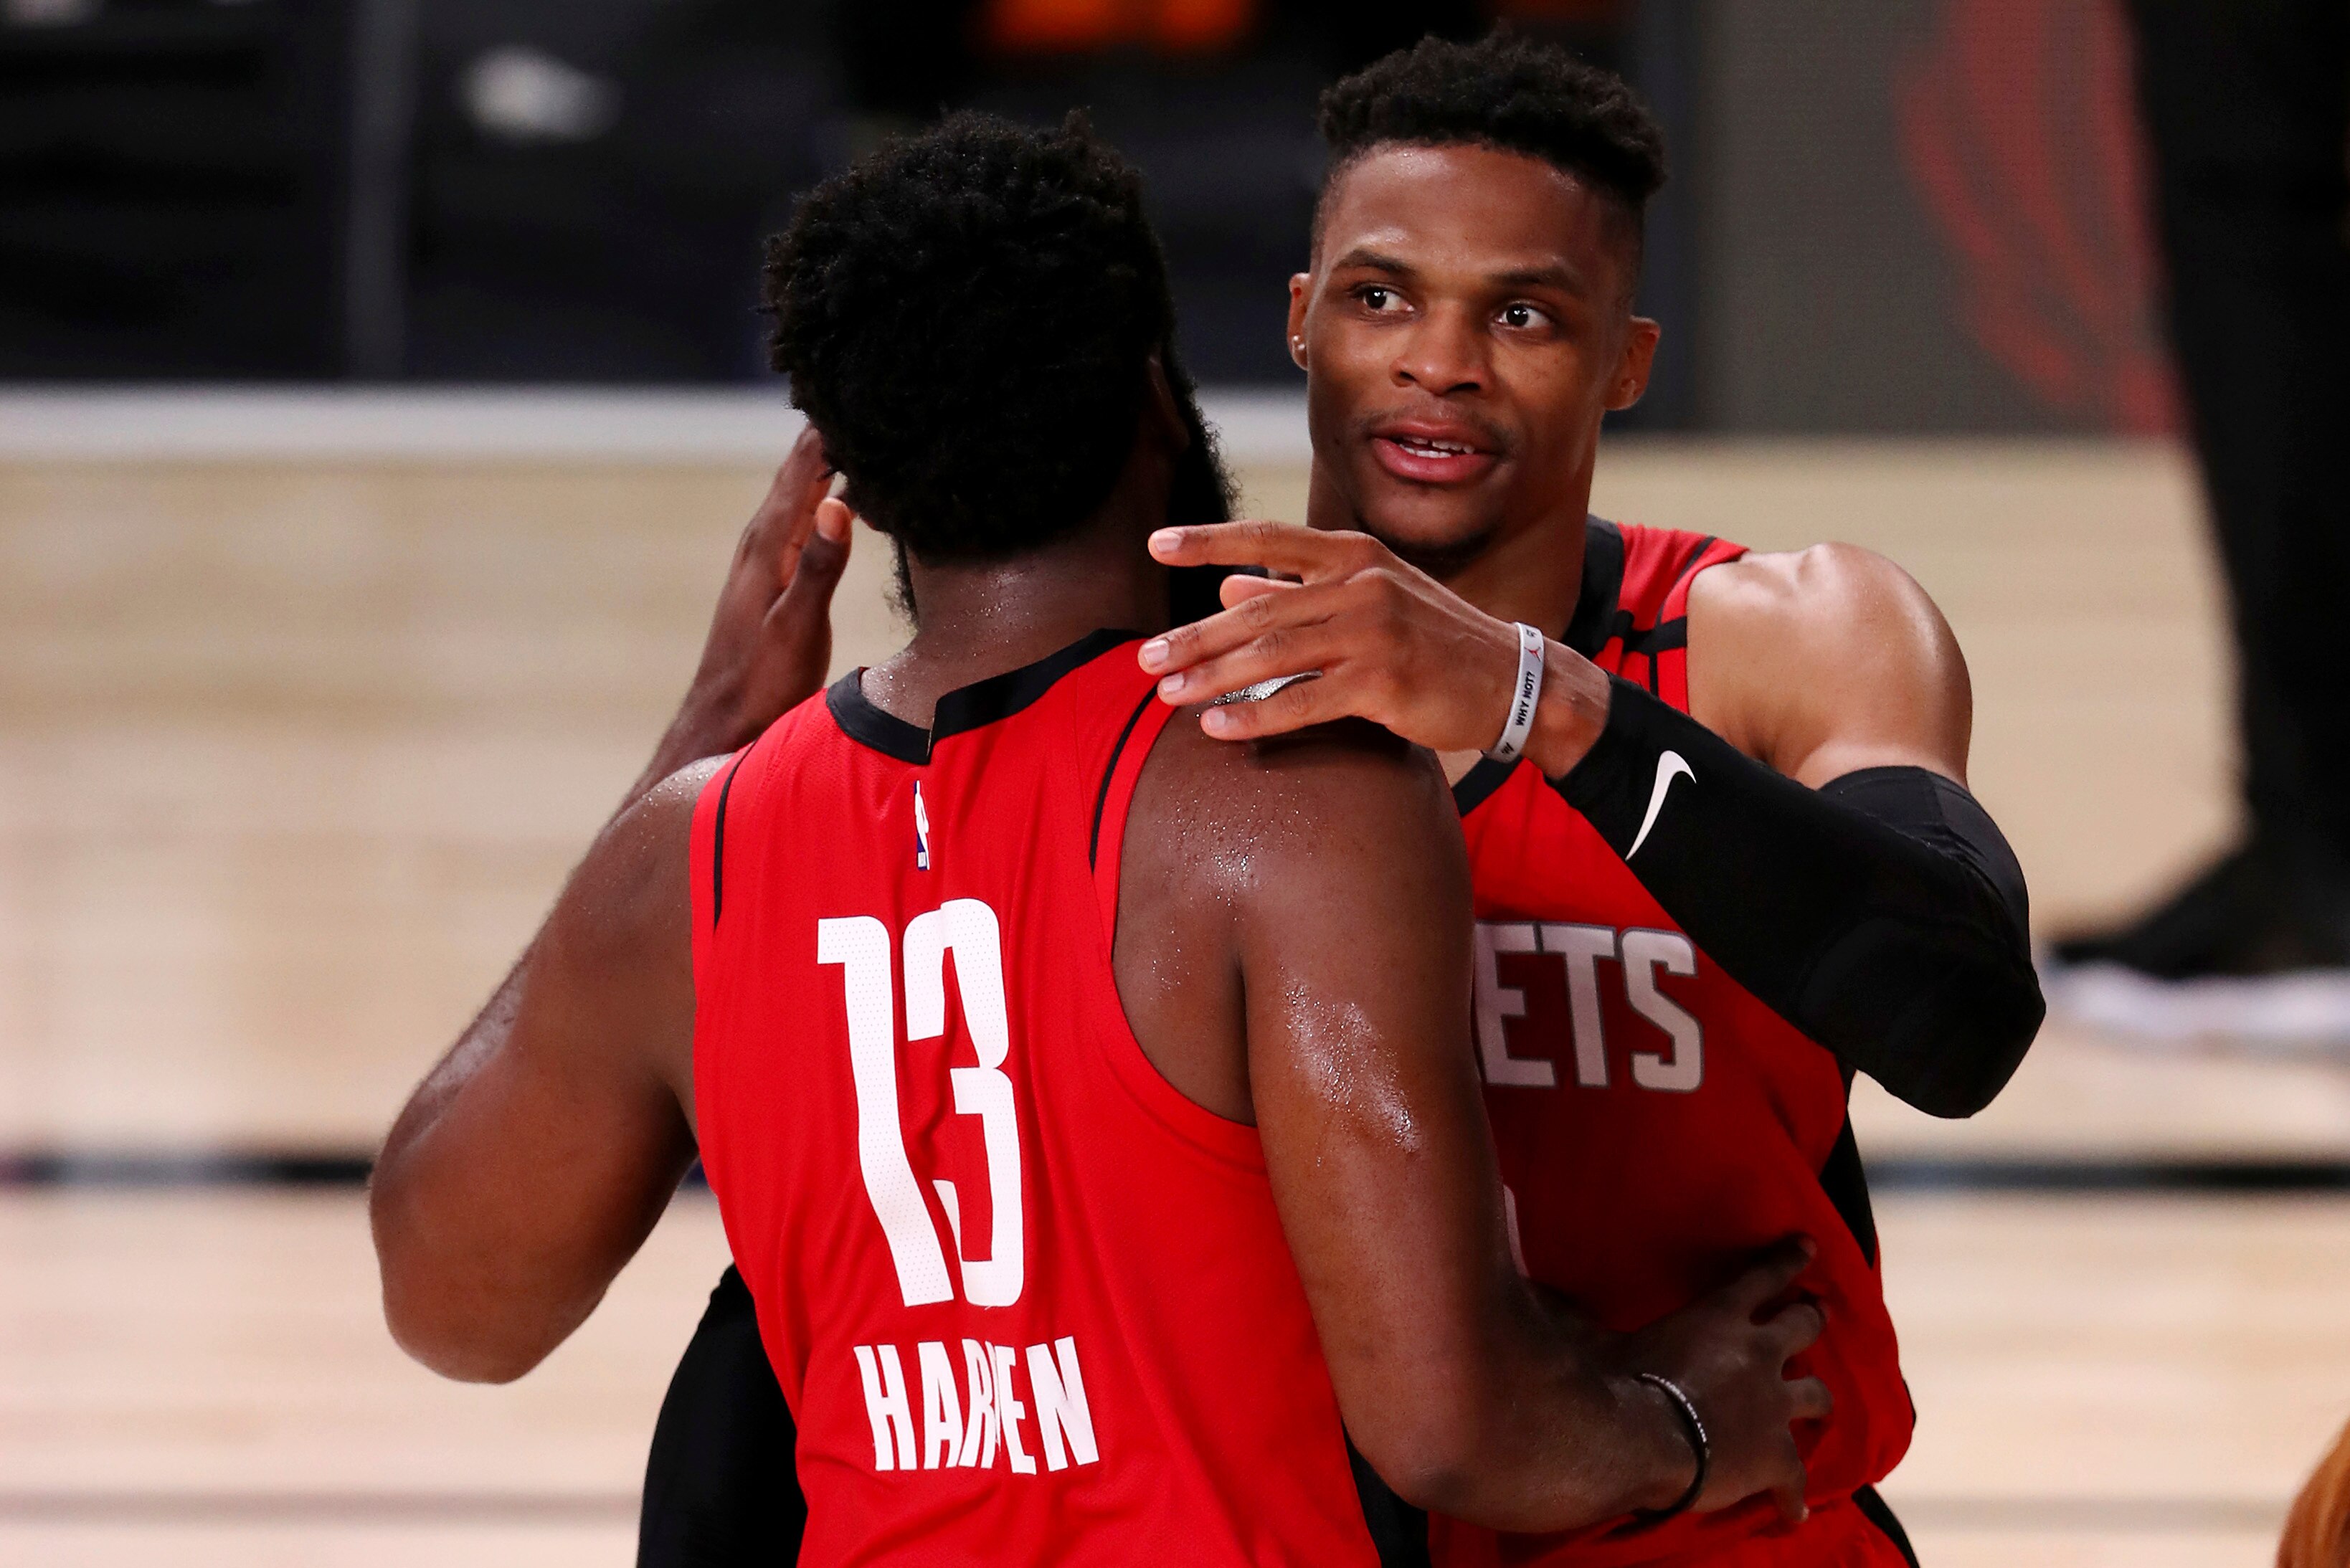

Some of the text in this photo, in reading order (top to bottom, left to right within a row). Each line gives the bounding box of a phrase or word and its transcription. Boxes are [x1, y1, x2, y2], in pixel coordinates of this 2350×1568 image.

[1516, 671, 1535, 726] WHY NOT?
[818, 898, 1024, 1307] 13
[853, 1336, 1099, 1475] HAREN
